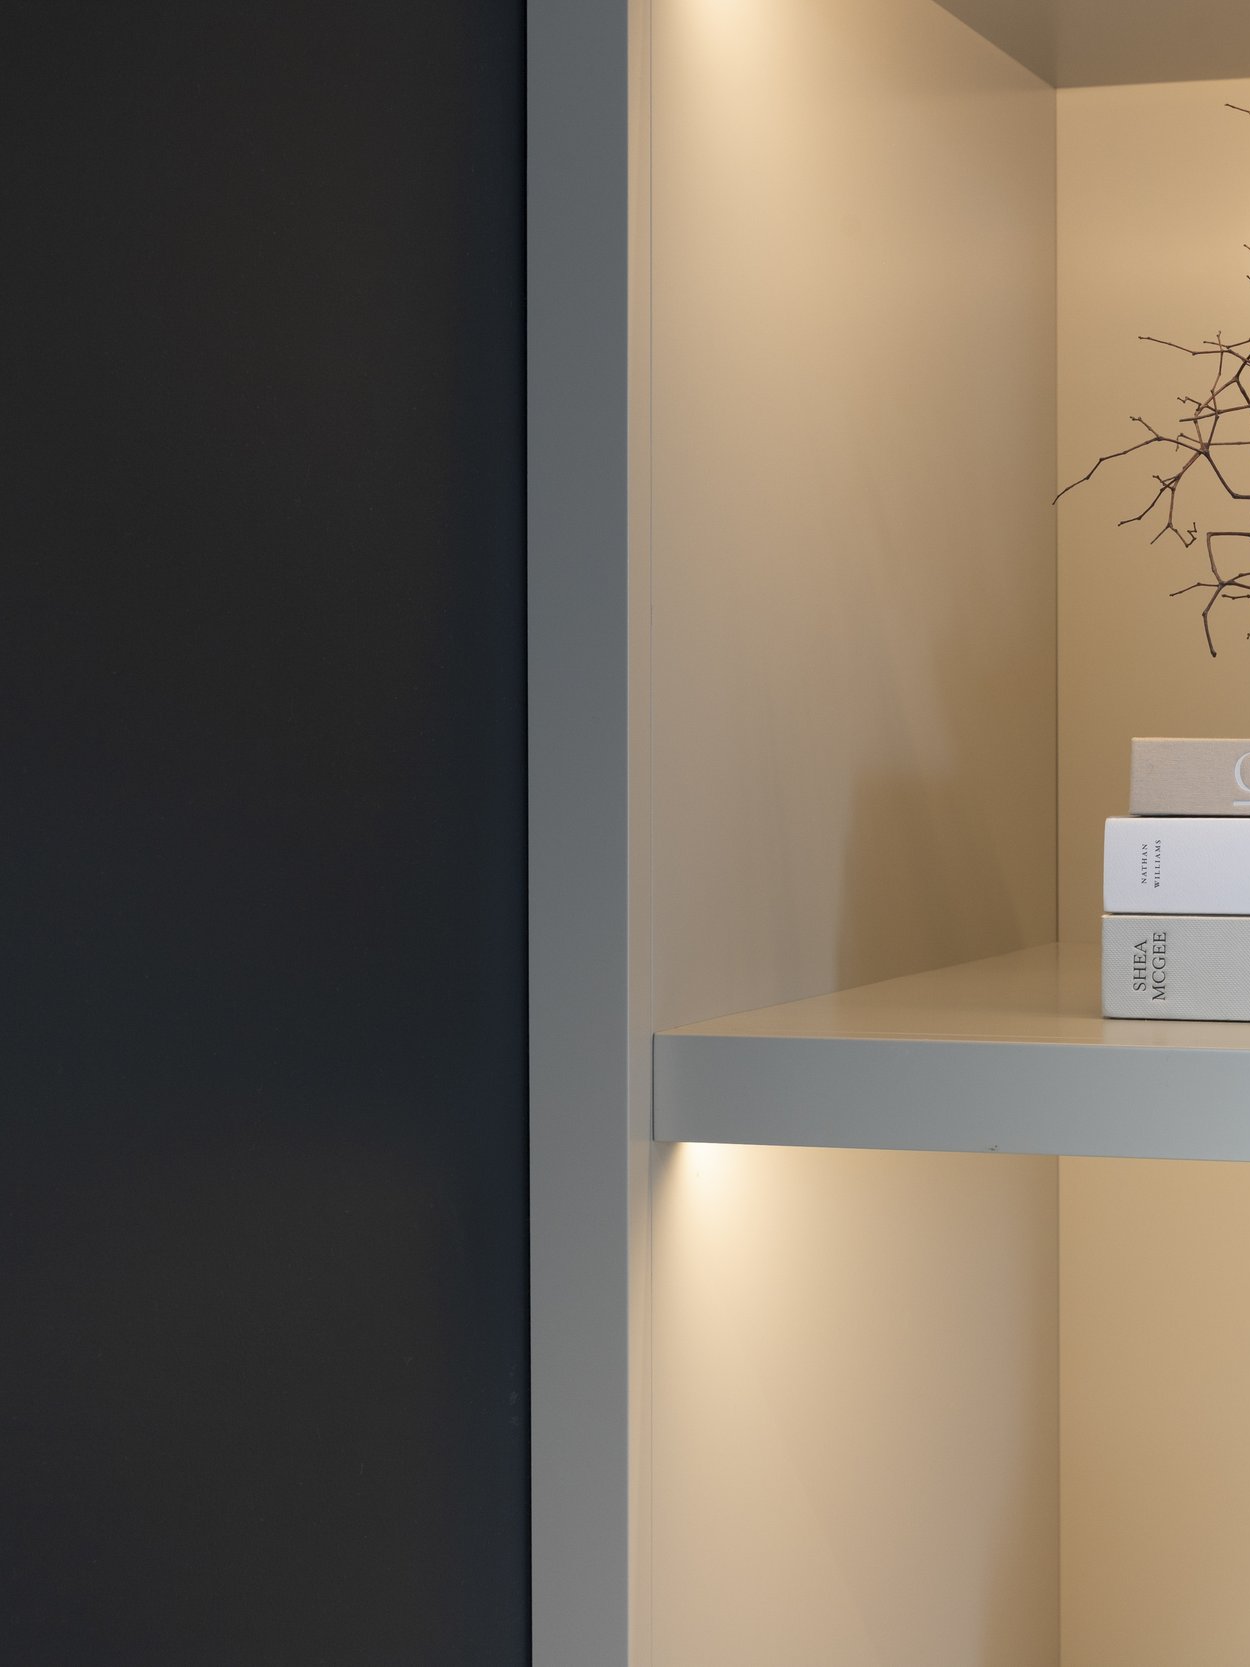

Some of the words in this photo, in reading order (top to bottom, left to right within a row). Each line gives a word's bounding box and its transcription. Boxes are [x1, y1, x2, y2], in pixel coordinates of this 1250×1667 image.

[1154, 839, 1162, 889] WILLIAMS
[1133, 940, 1148, 992] SHEA
[1152, 931, 1167, 1001] MCGEE
